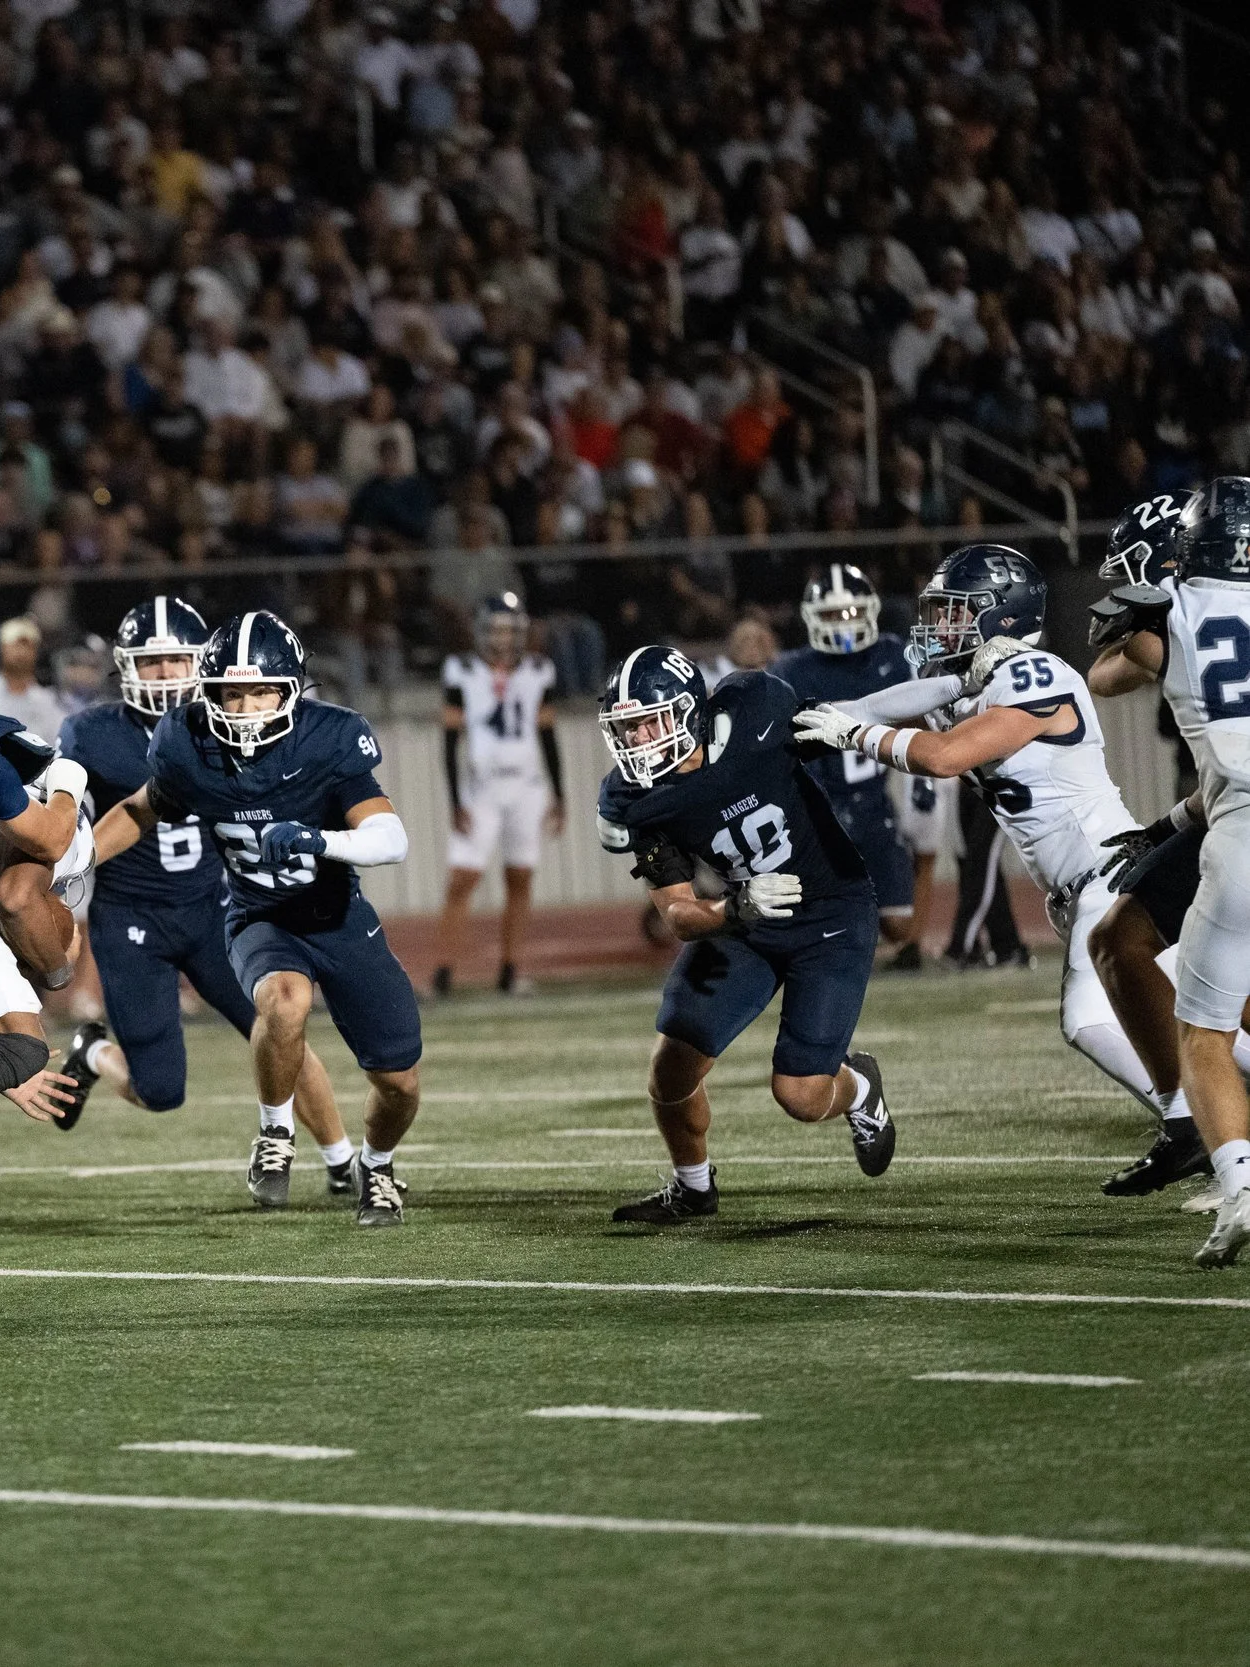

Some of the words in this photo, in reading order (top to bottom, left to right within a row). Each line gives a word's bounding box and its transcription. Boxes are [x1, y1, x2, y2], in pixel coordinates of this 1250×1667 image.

[1132, 494, 1182, 531] 22
[983, 555, 1027, 584] 55
[227, 669, 258, 678] Riddell
[661, 653, 695, 685] 18
[1009, 656, 1055, 694] 55
[482, 698, 522, 738] 41
[234, 808, 274, 822] RANGERS
[720, 794, 760, 822] RANGERS
